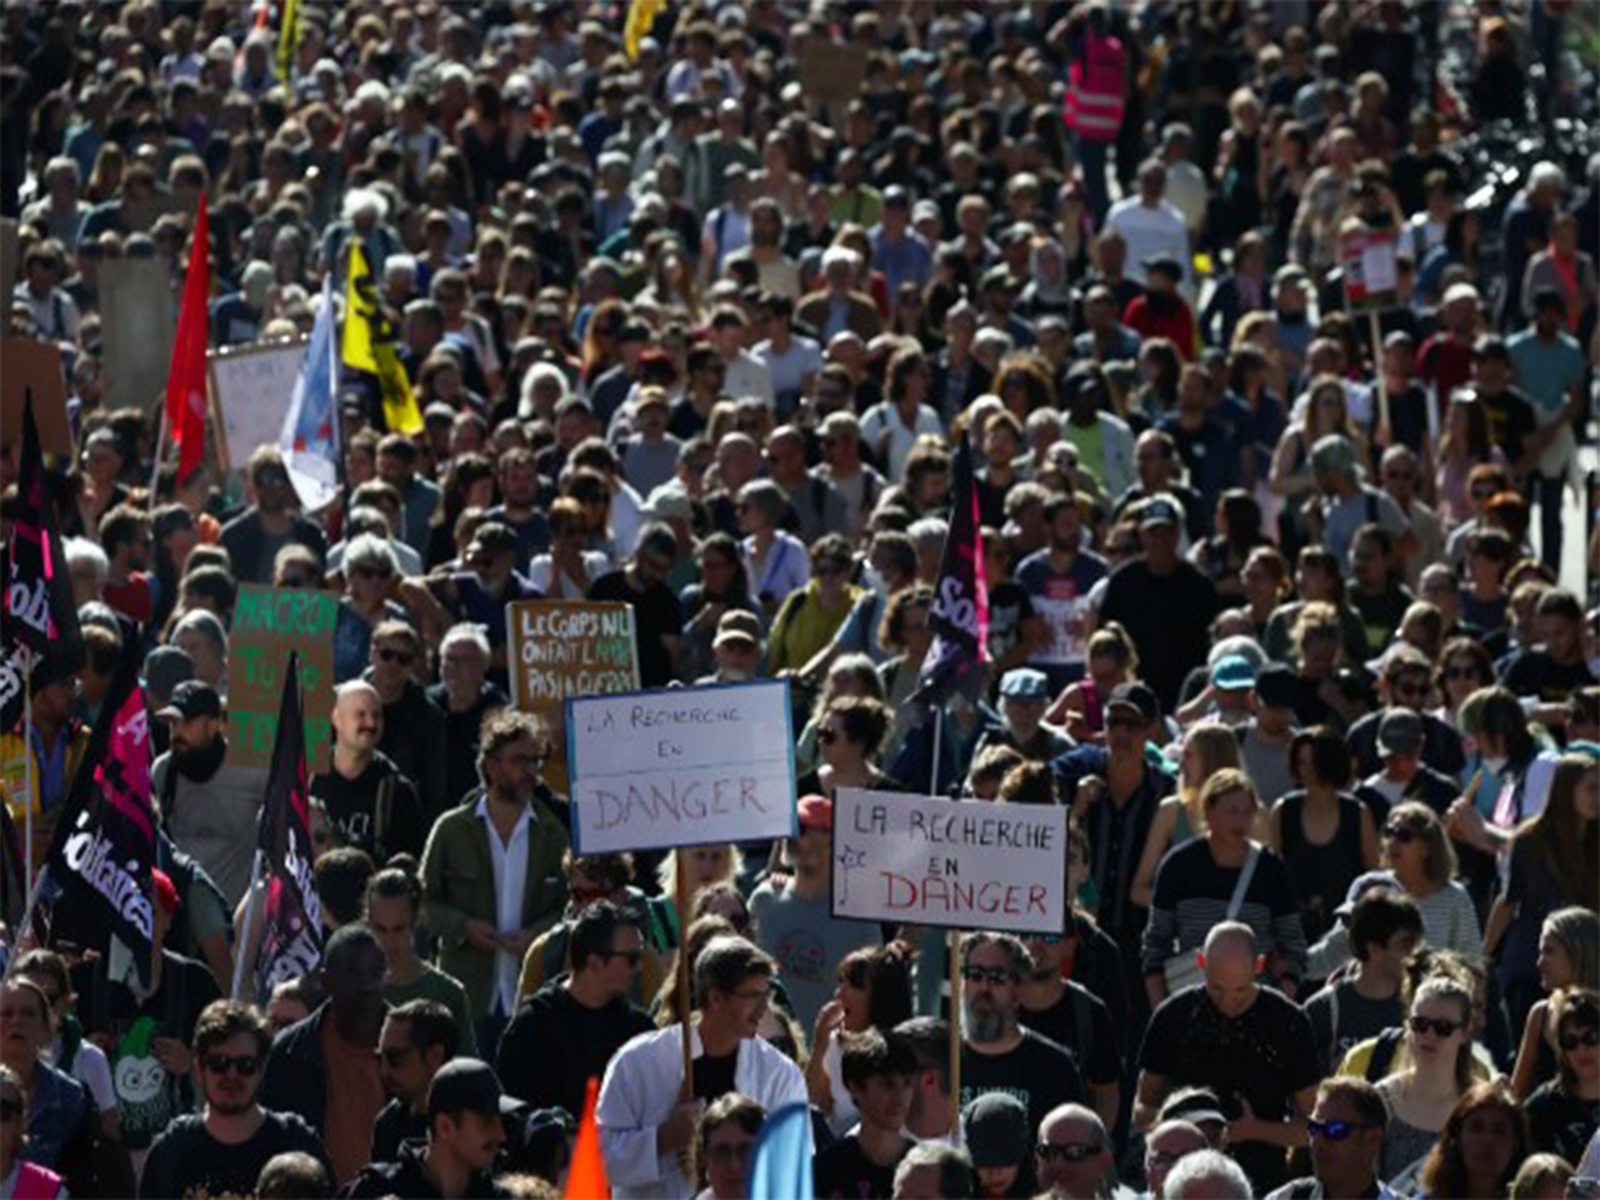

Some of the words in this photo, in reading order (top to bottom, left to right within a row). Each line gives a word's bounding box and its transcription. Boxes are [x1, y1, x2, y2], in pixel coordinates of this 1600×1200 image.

[234, 586, 335, 633] MACRON
[588, 777, 767, 830] DANGER
[854, 804, 887, 835] LA
[910, 809, 1058, 850] RECHERCHE
[928, 856, 959, 876] EN
[880, 870, 1048, 915] DANGER
